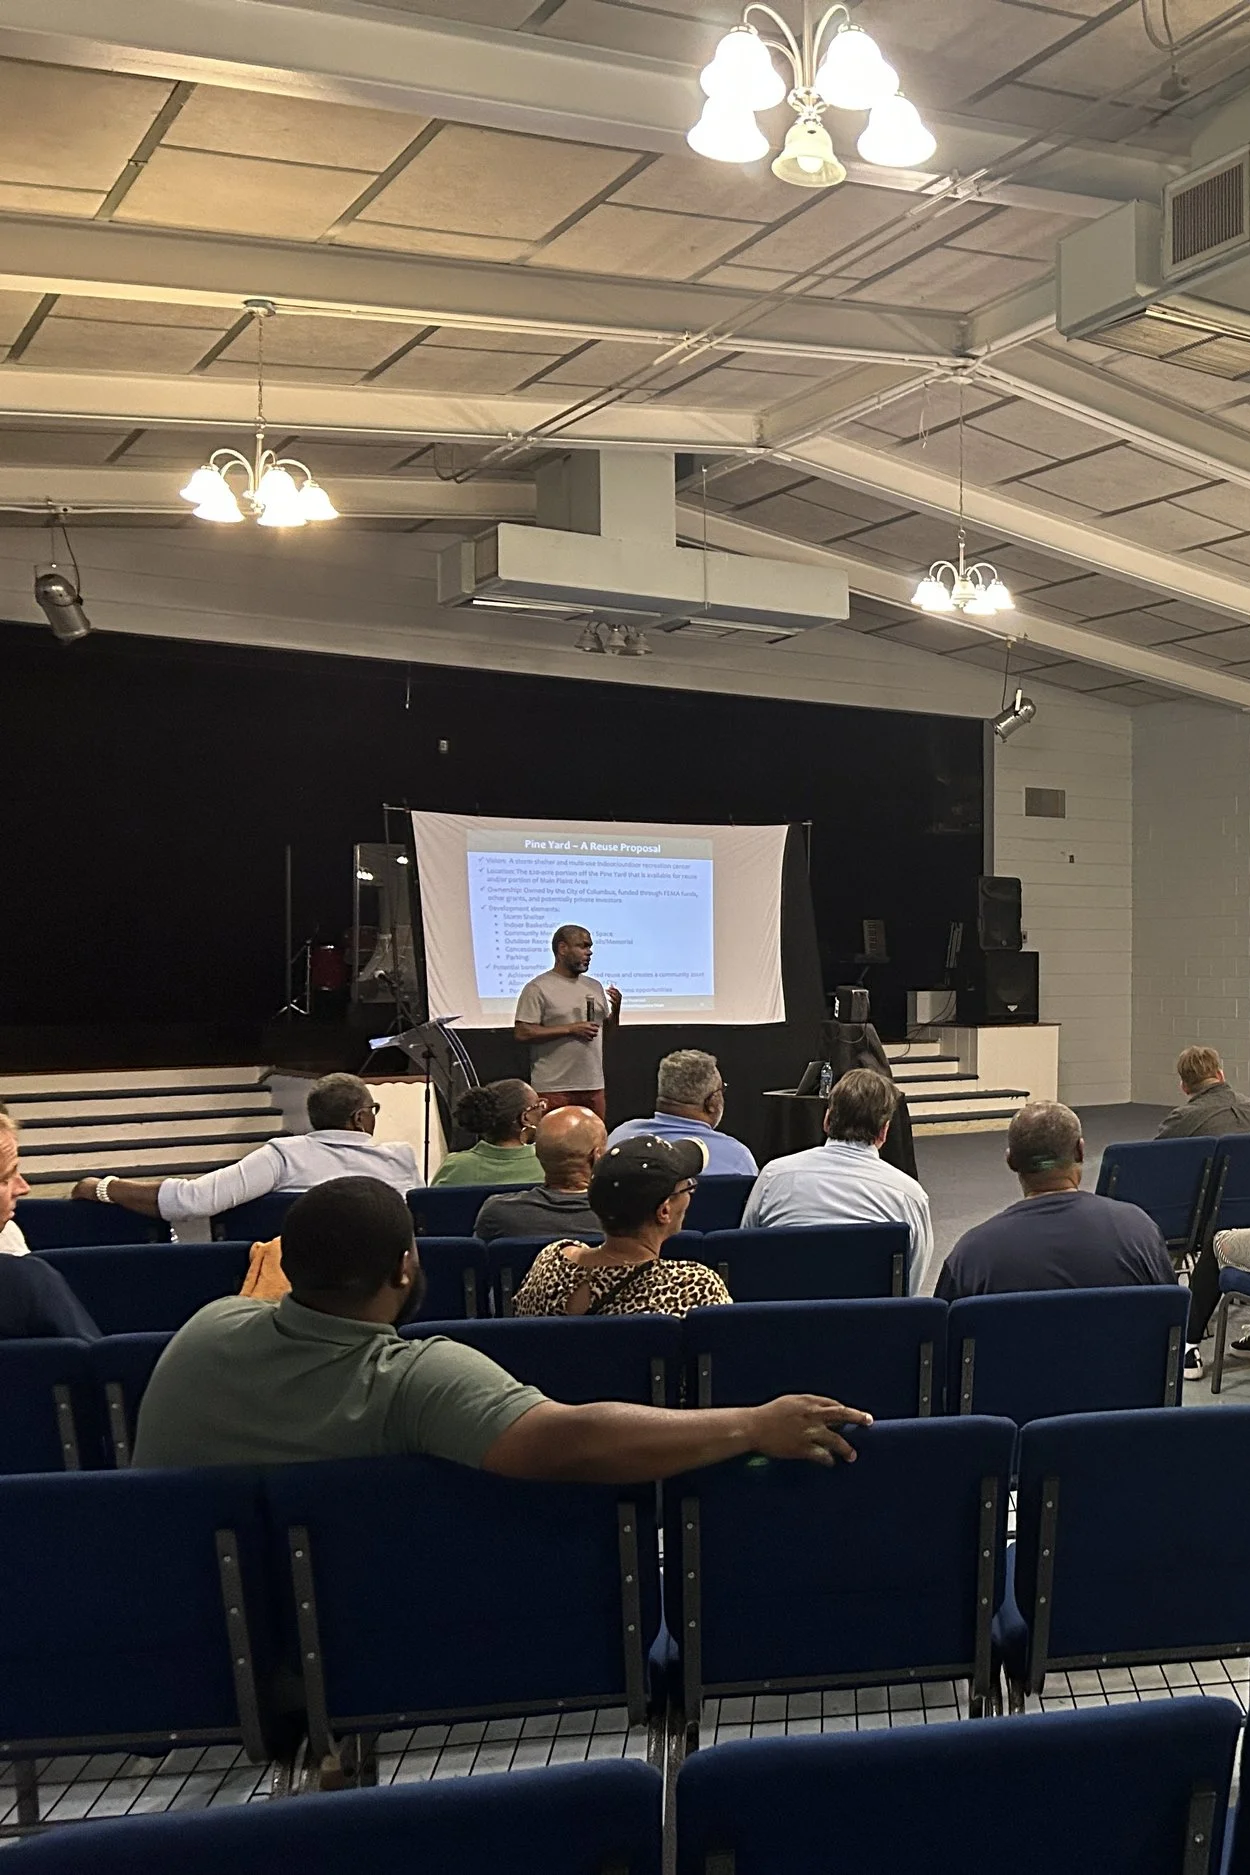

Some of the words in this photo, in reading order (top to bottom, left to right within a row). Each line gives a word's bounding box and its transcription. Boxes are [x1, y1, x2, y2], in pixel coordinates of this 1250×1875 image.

[524, 840, 546, 849] Pine
[548, 840, 570, 850] Yard
[580, 841, 588, 850] A
[590, 842, 618, 851] Reuse
[620, 843, 661, 854] Proposal
